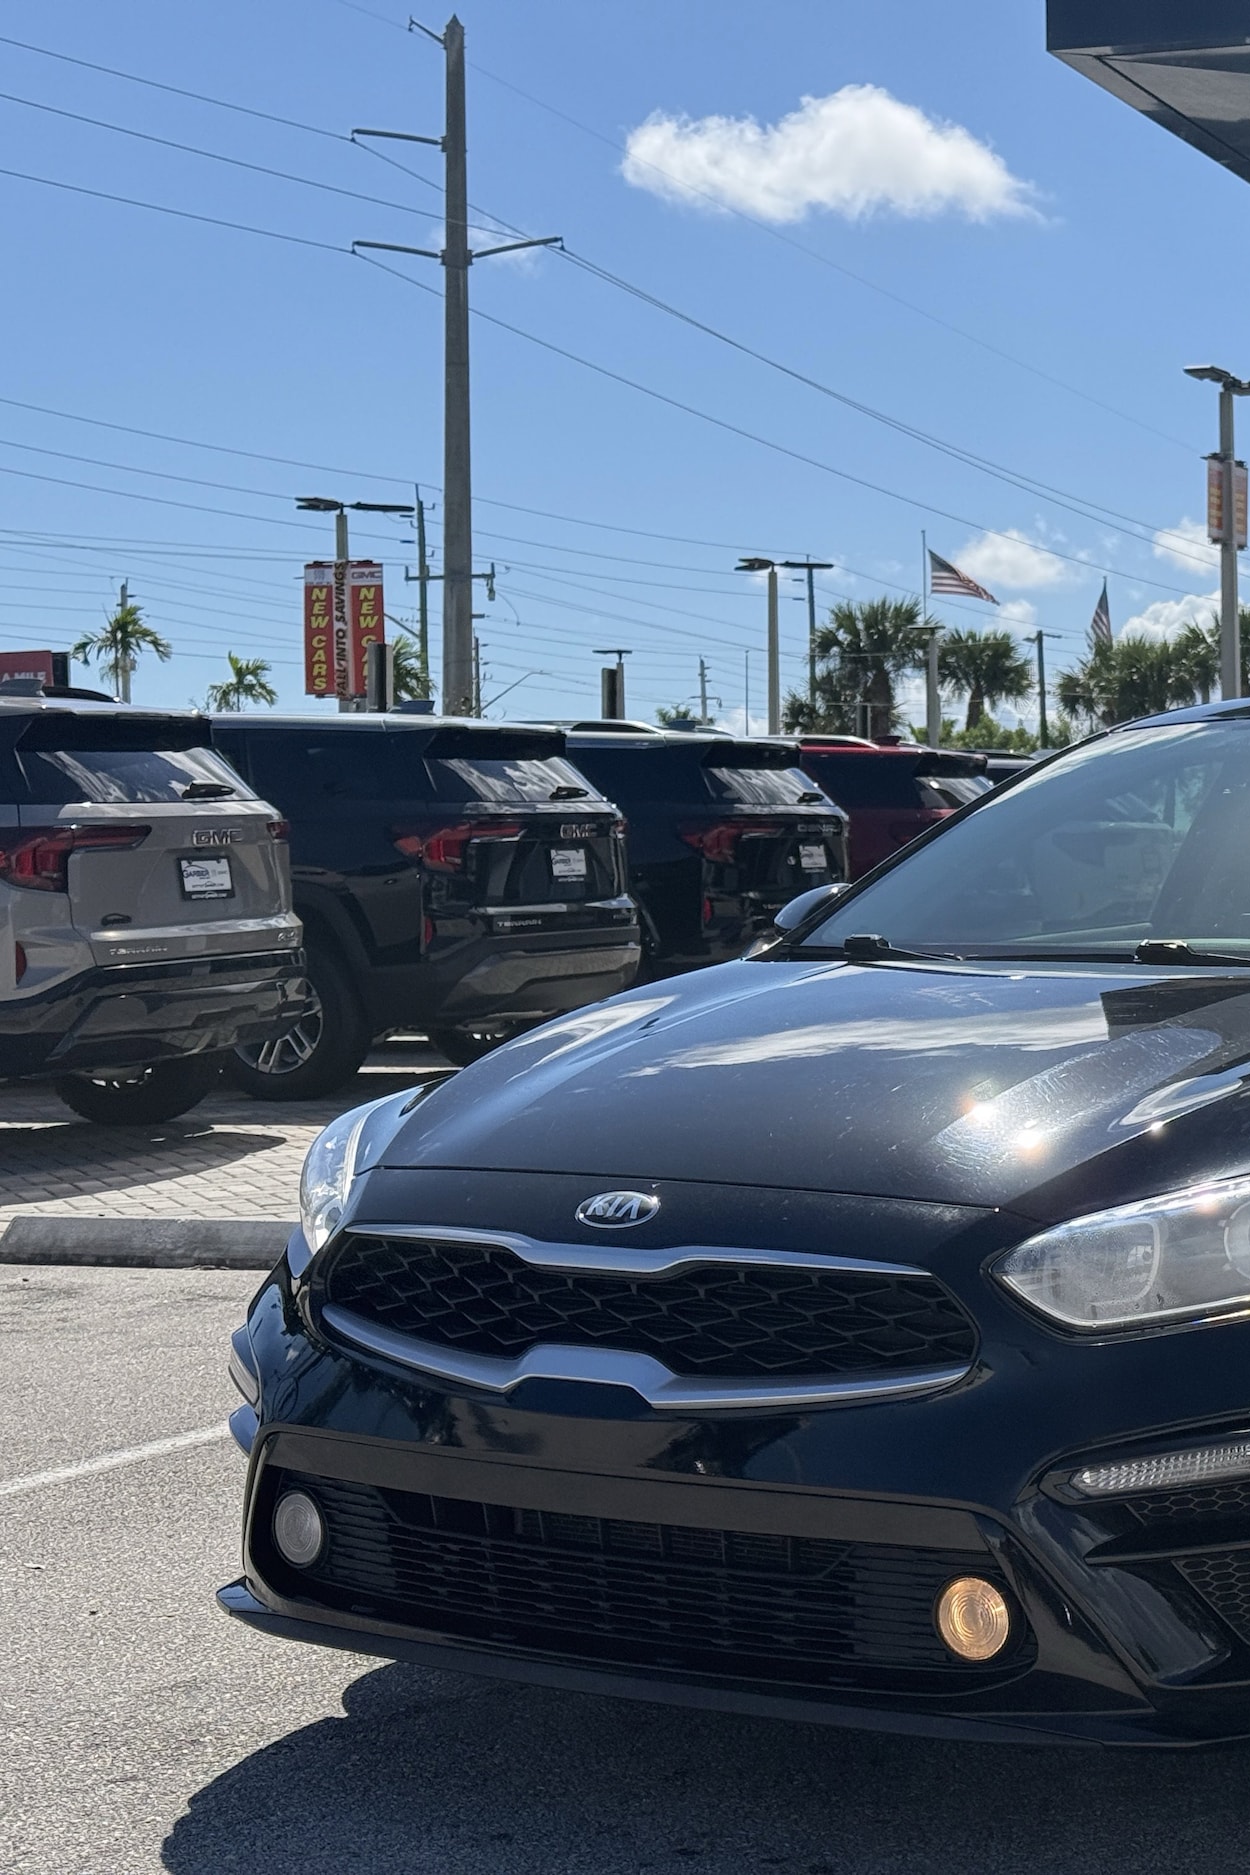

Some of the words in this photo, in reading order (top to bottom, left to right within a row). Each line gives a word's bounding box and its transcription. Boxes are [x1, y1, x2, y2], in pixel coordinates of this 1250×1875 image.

[335, 561, 347, 623] SAVINGS
[351, 571, 382, 579] GMC
[310, 587, 329, 629] NEW
[359, 587, 379, 629] NEW
[311, 635, 327, 690] CARS
[335, 628, 348, 664] INTO
[336, 665, 347, 697] FALL
[193, 829, 243, 845] GMC
[560, 823, 597, 839] GMC
[585, 1196, 641, 1219] KIA
